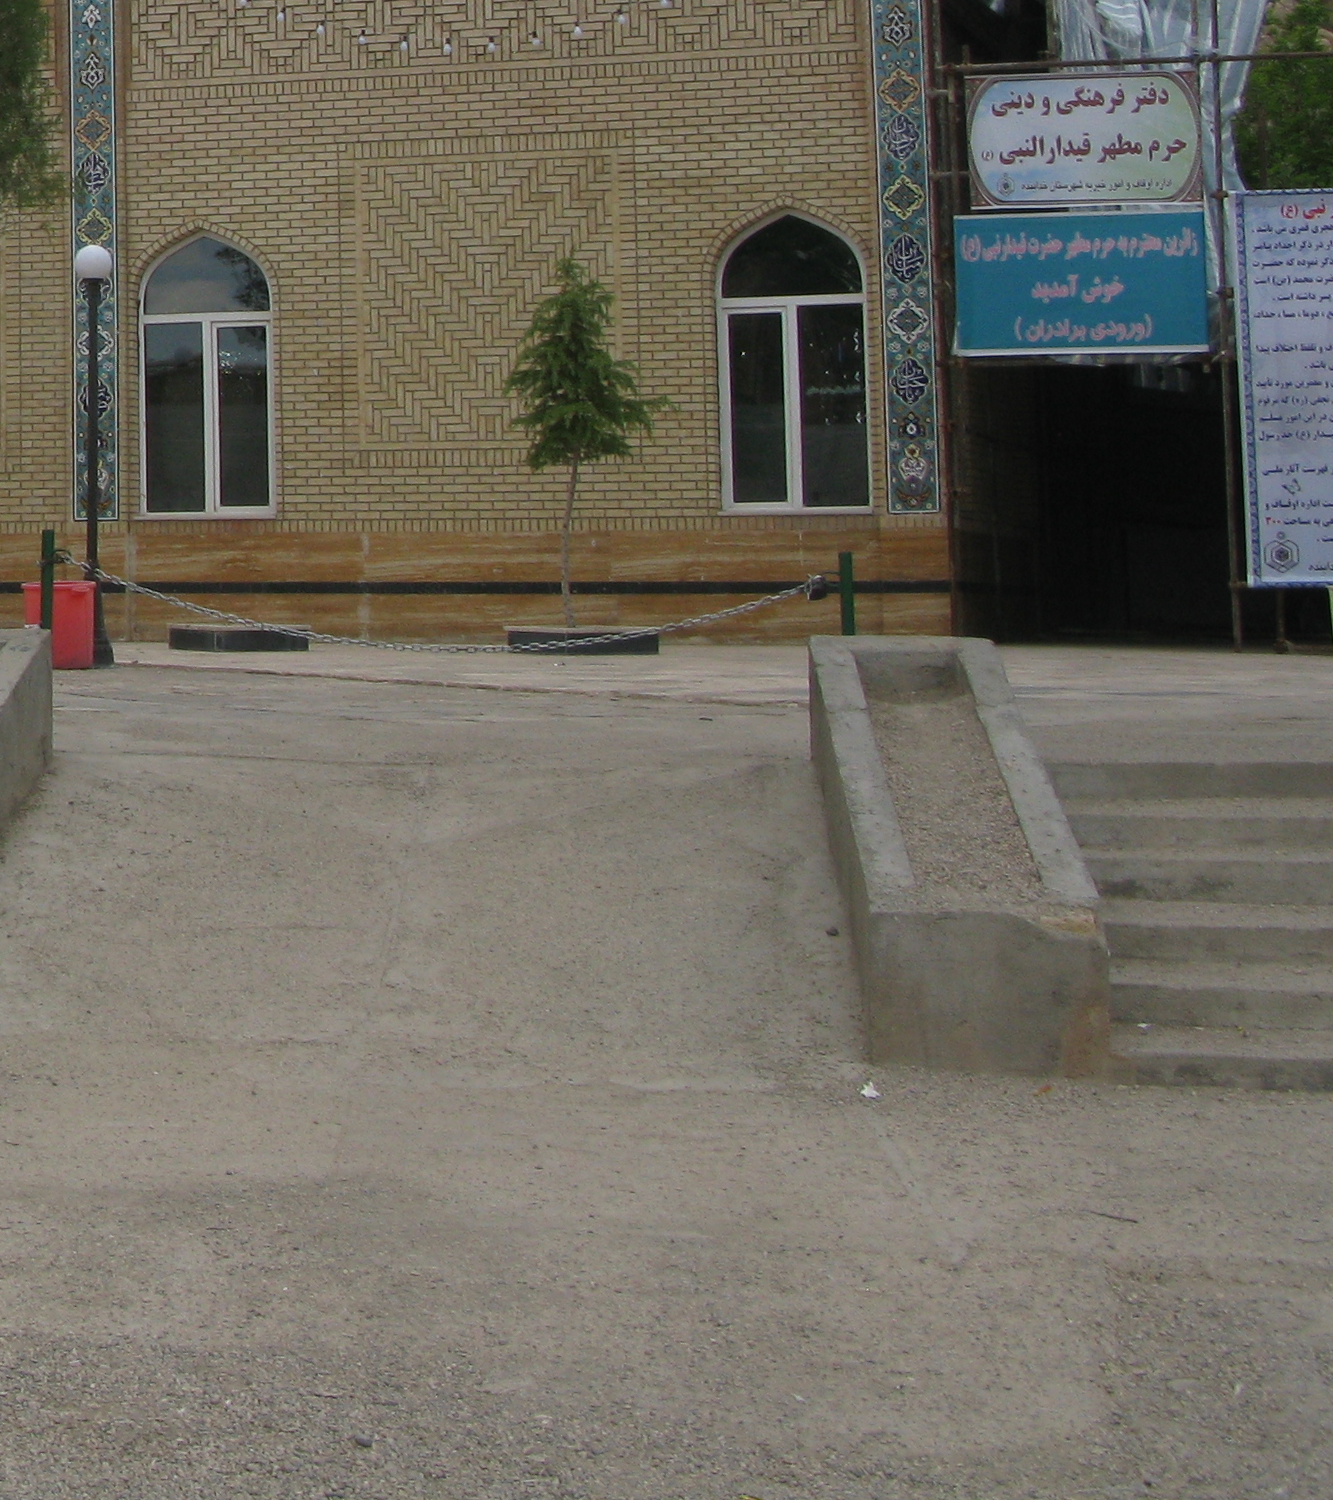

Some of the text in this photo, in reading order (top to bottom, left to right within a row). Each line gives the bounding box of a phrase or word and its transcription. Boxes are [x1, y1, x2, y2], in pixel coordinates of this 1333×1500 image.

[992, 81, 1170, 117] دفتر فرهنگی و دینی
[1097, 133, 1142, 163] مطهر
[1148, 138, 1187, 162] حرم
[1032, 274, 1125, 303] خوش آمدید
